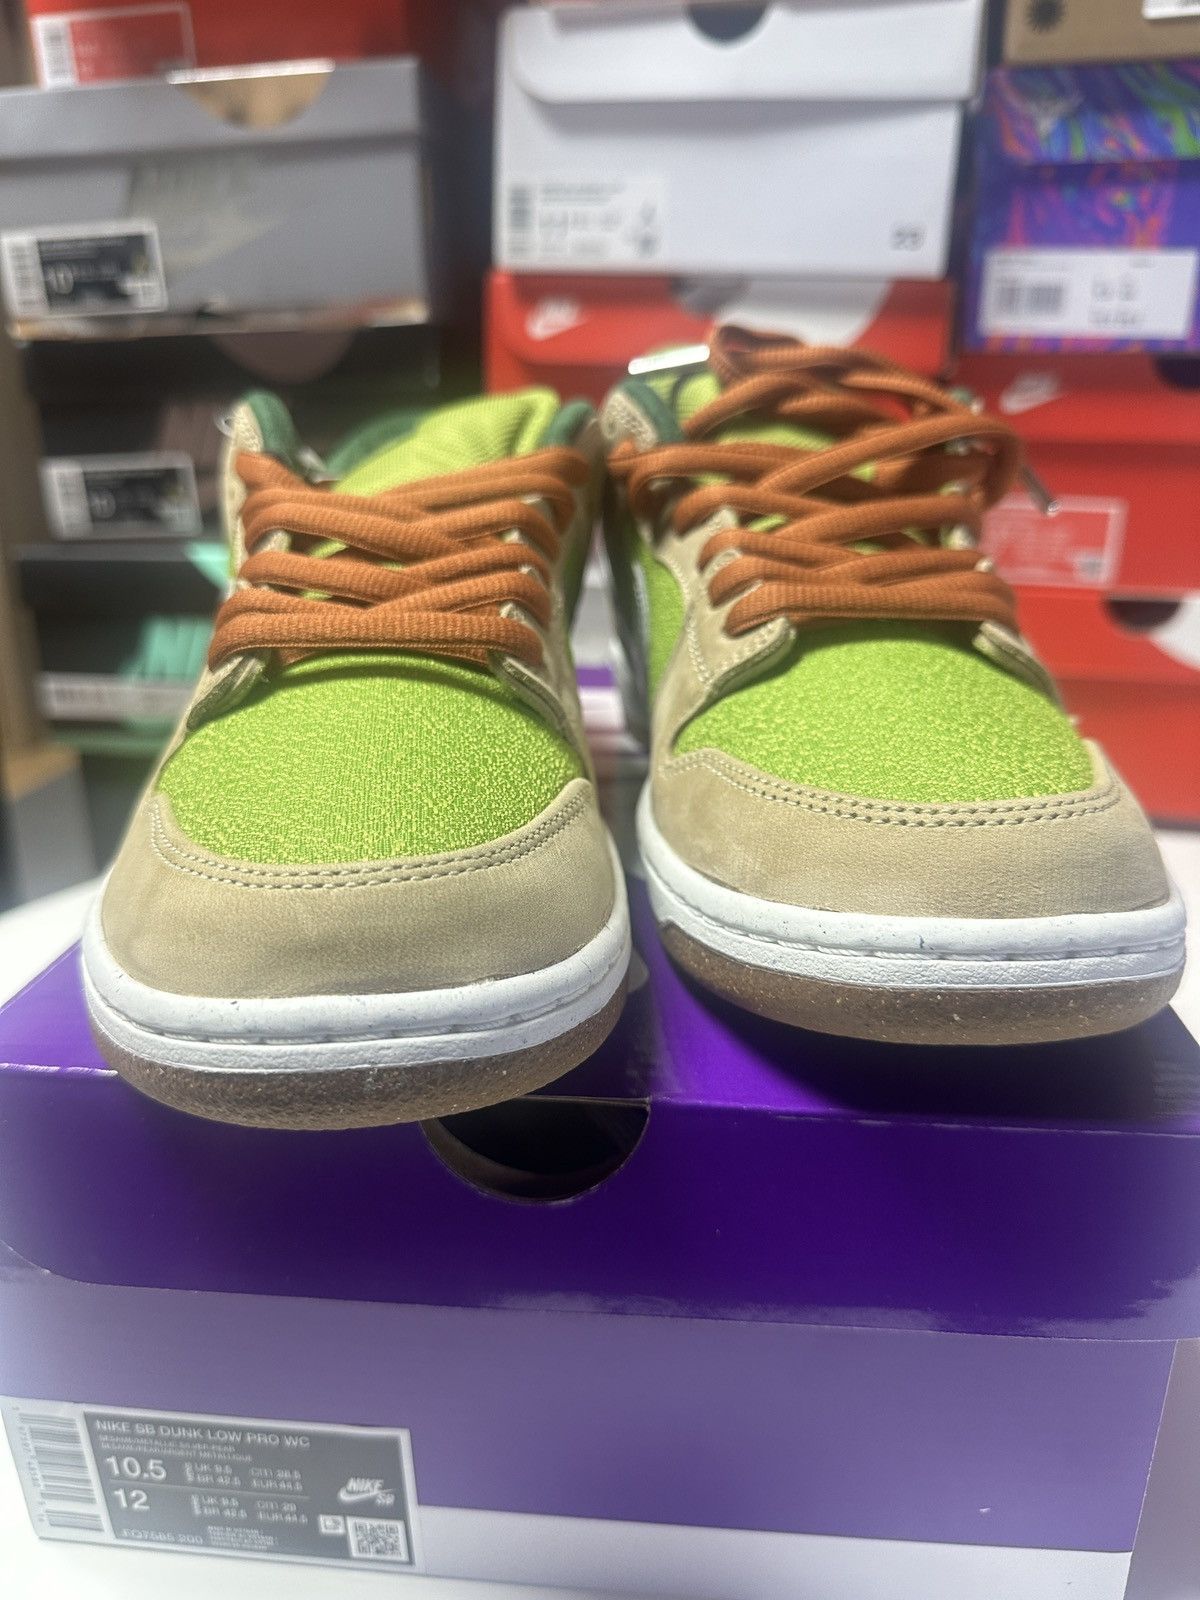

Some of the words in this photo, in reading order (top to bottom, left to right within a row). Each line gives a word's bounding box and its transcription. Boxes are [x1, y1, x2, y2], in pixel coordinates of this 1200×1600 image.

[95, 1419, 130, 1432] NIKE
[135, 1423, 156, 1434] SB
[160, 1425, 203, 1438] DUNK
[207, 1429, 242, 1442] LOW
[246, 1432, 280, 1446] PRO
[106, 1456, 167, 1480] 10.5
[345, 1477, 384, 1493] NIKE
[113, 1488, 150, 1510] 12
